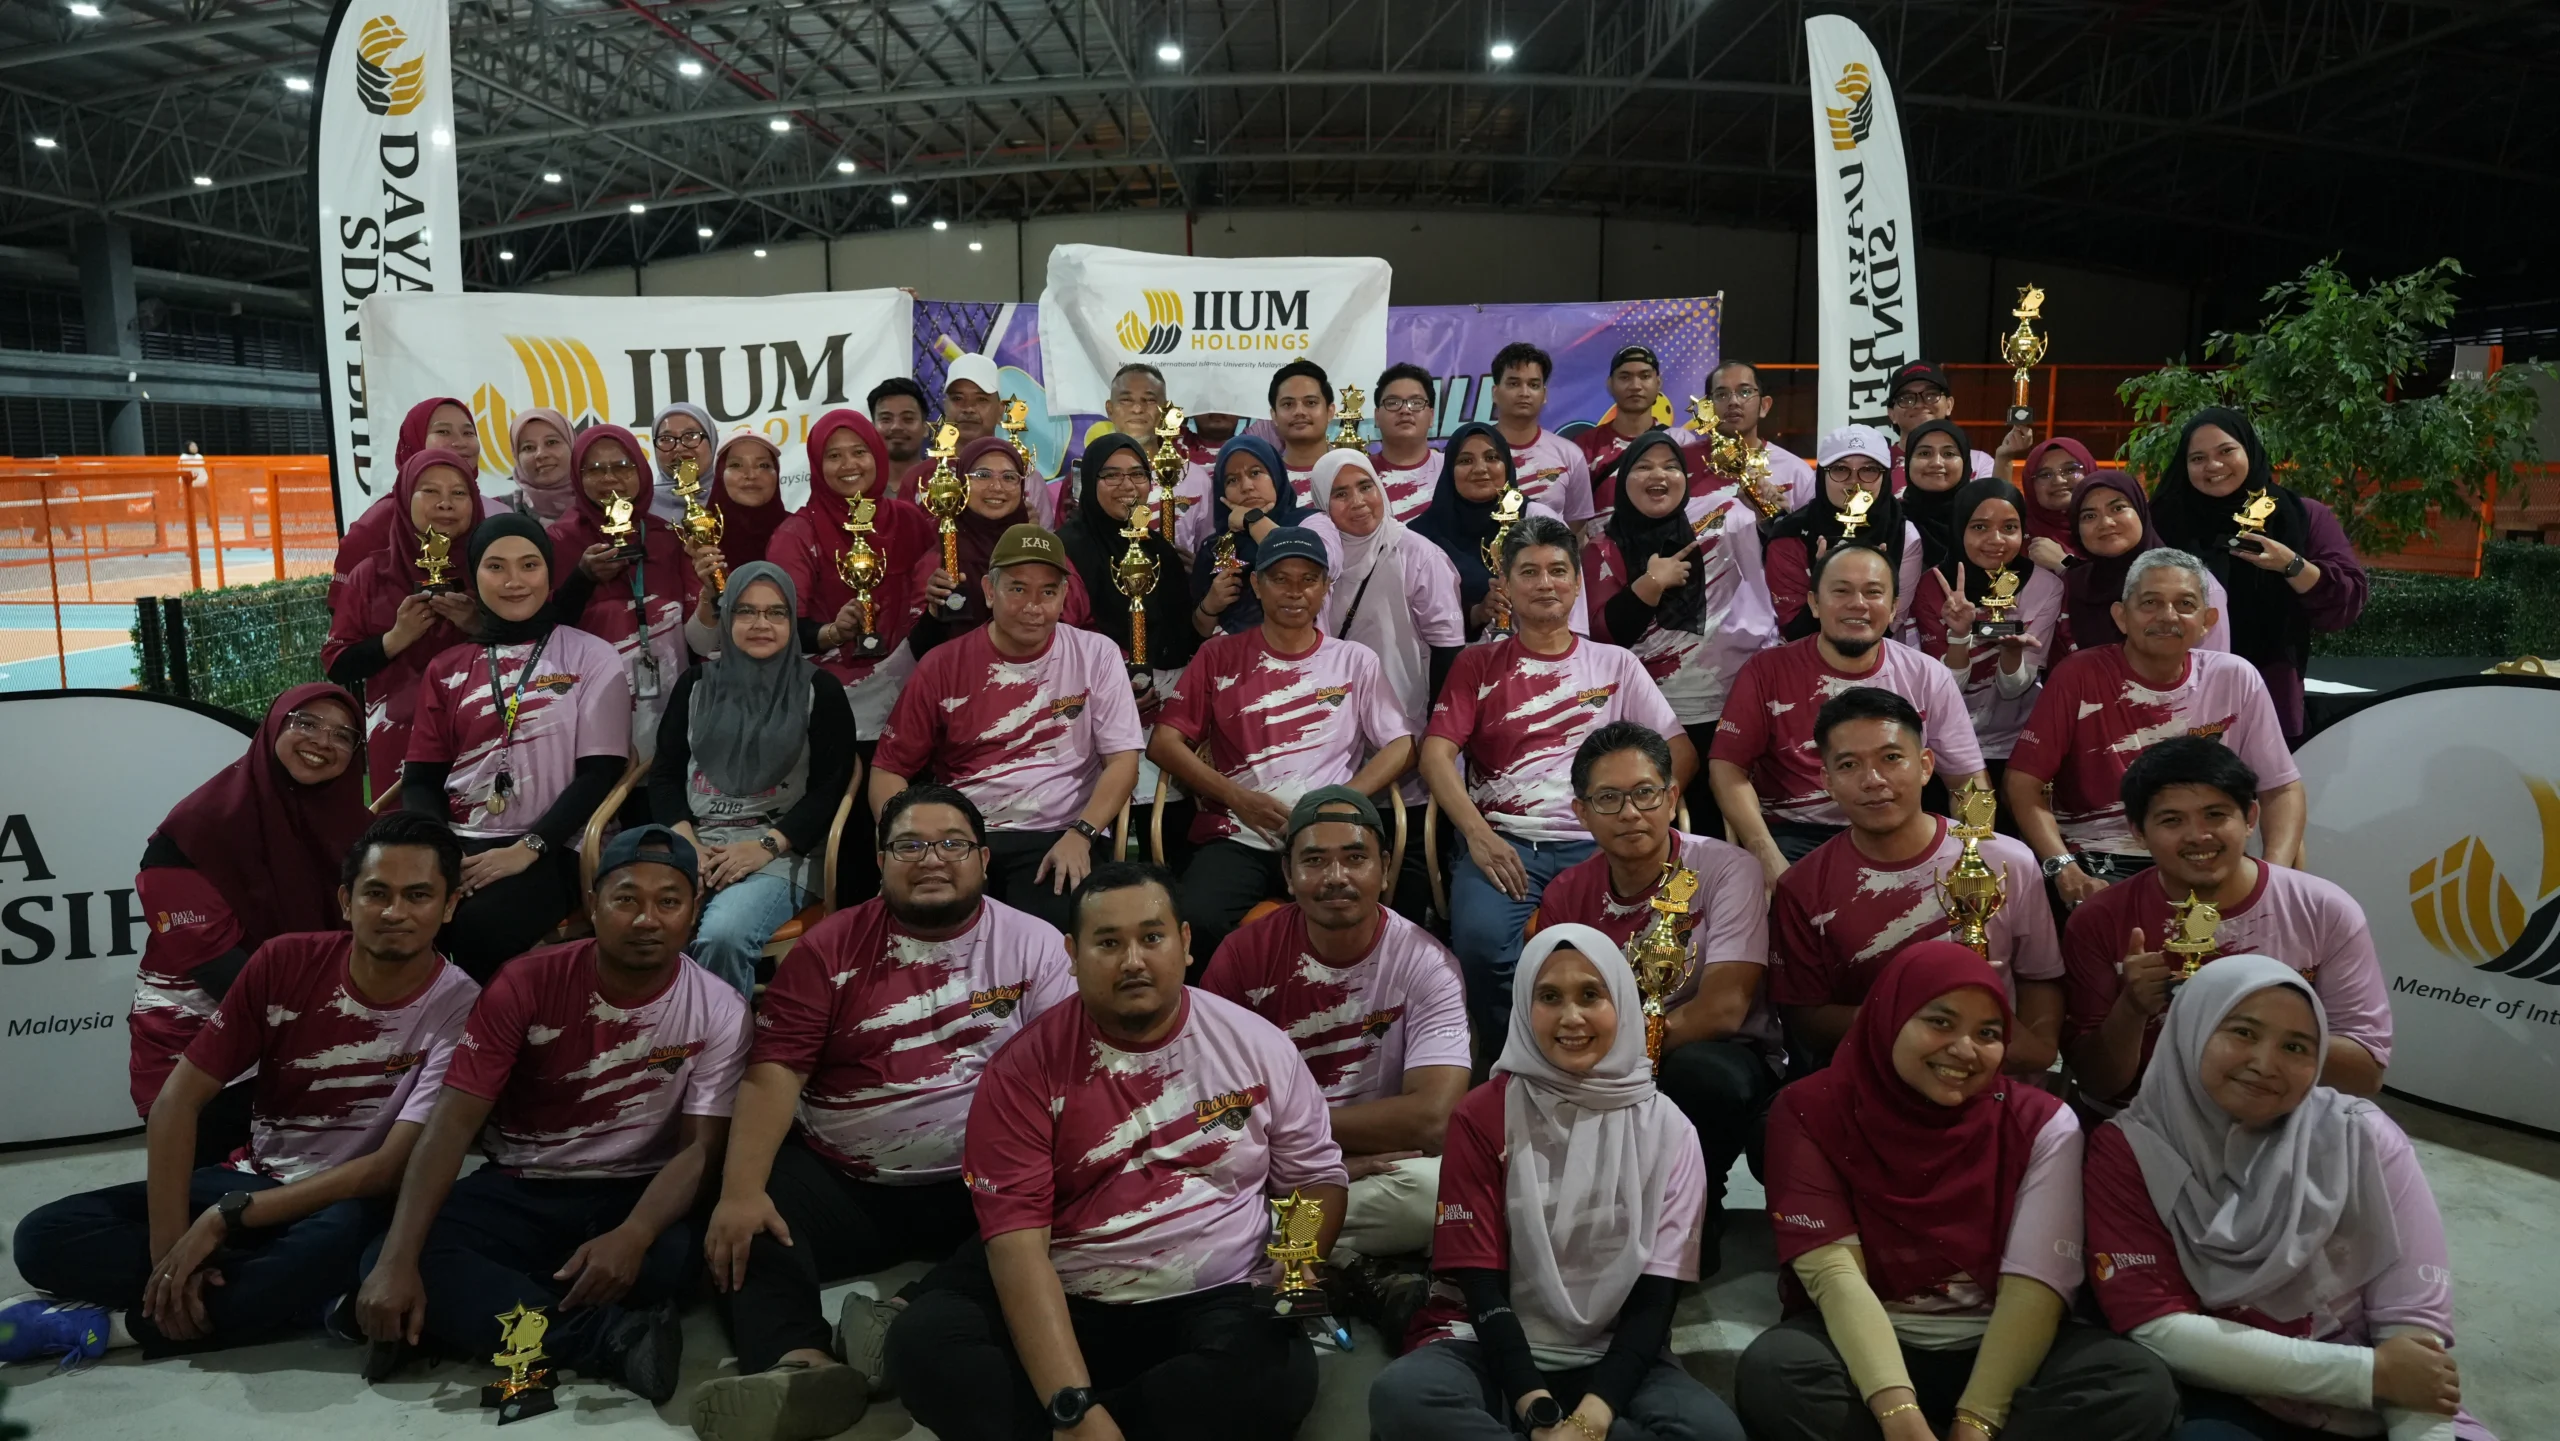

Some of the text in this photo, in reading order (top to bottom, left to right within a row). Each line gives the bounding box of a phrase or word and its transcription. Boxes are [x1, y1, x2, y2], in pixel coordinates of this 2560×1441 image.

[1192, 290, 1310, 331] IIUM
[1191, 333, 1310, 350] HOLDINGS
[1223, 361, 1255, 369] University
[625, 333, 852, 428] IIUM
[1021, 537, 1051, 552] KAR
[709, 801, 743, 815] 2018
[171, 910, 195, 921] DAYA
[172, 915, 206, 927] BERSIH
[969, 985, 1021, 1004] Pickleball
[2392, 976, 2560, 1026] Member of Int
[7, 1012, 114, 1037] Malaysia
[1194, 1089, 1254, 1117] Pickleball
[1445, 1204, 1463, 1212] DAYA
[1445, 1211, 1473, 1220] BERSIH
